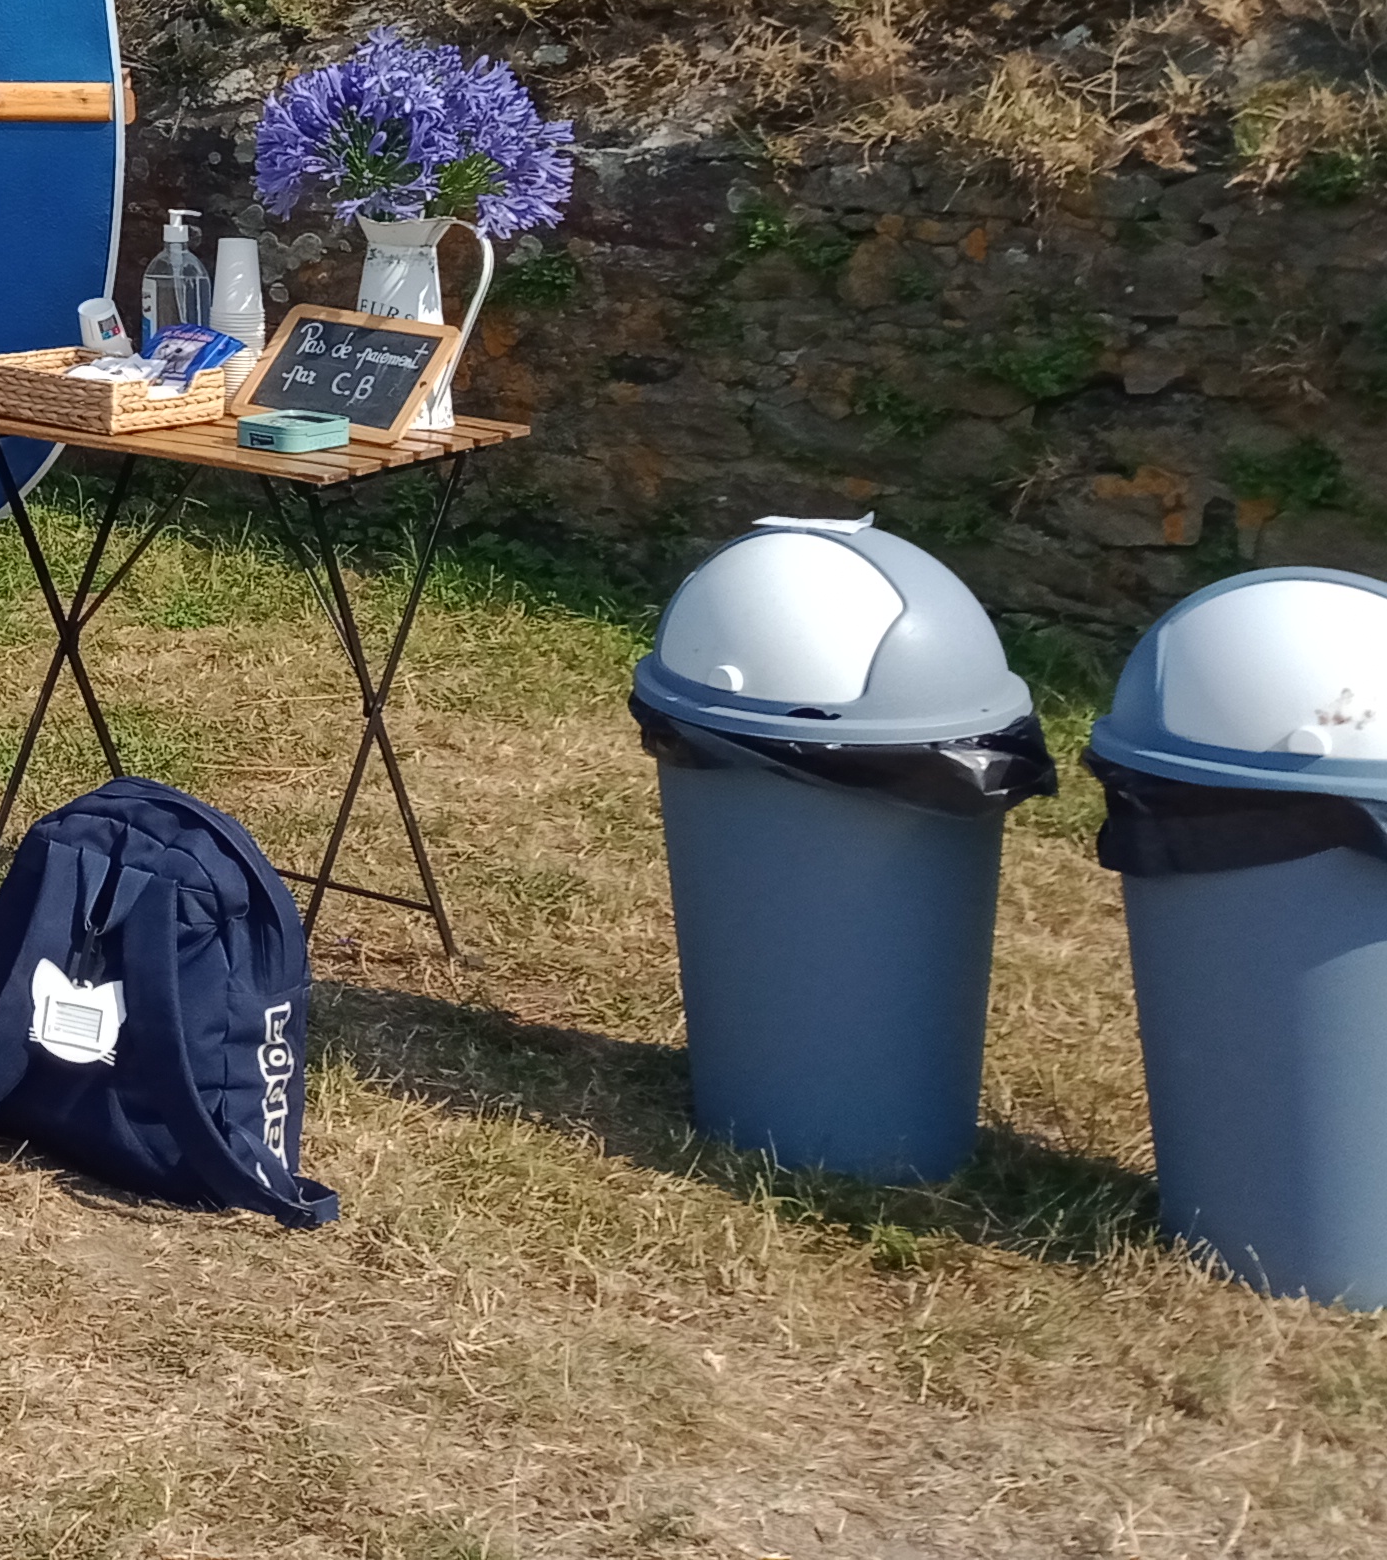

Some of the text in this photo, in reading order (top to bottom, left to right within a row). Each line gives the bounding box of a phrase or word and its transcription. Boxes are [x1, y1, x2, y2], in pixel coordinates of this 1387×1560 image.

[296, 323, 429, 371] Pas de paiement
[282, 365, 375, 400] par C.B
